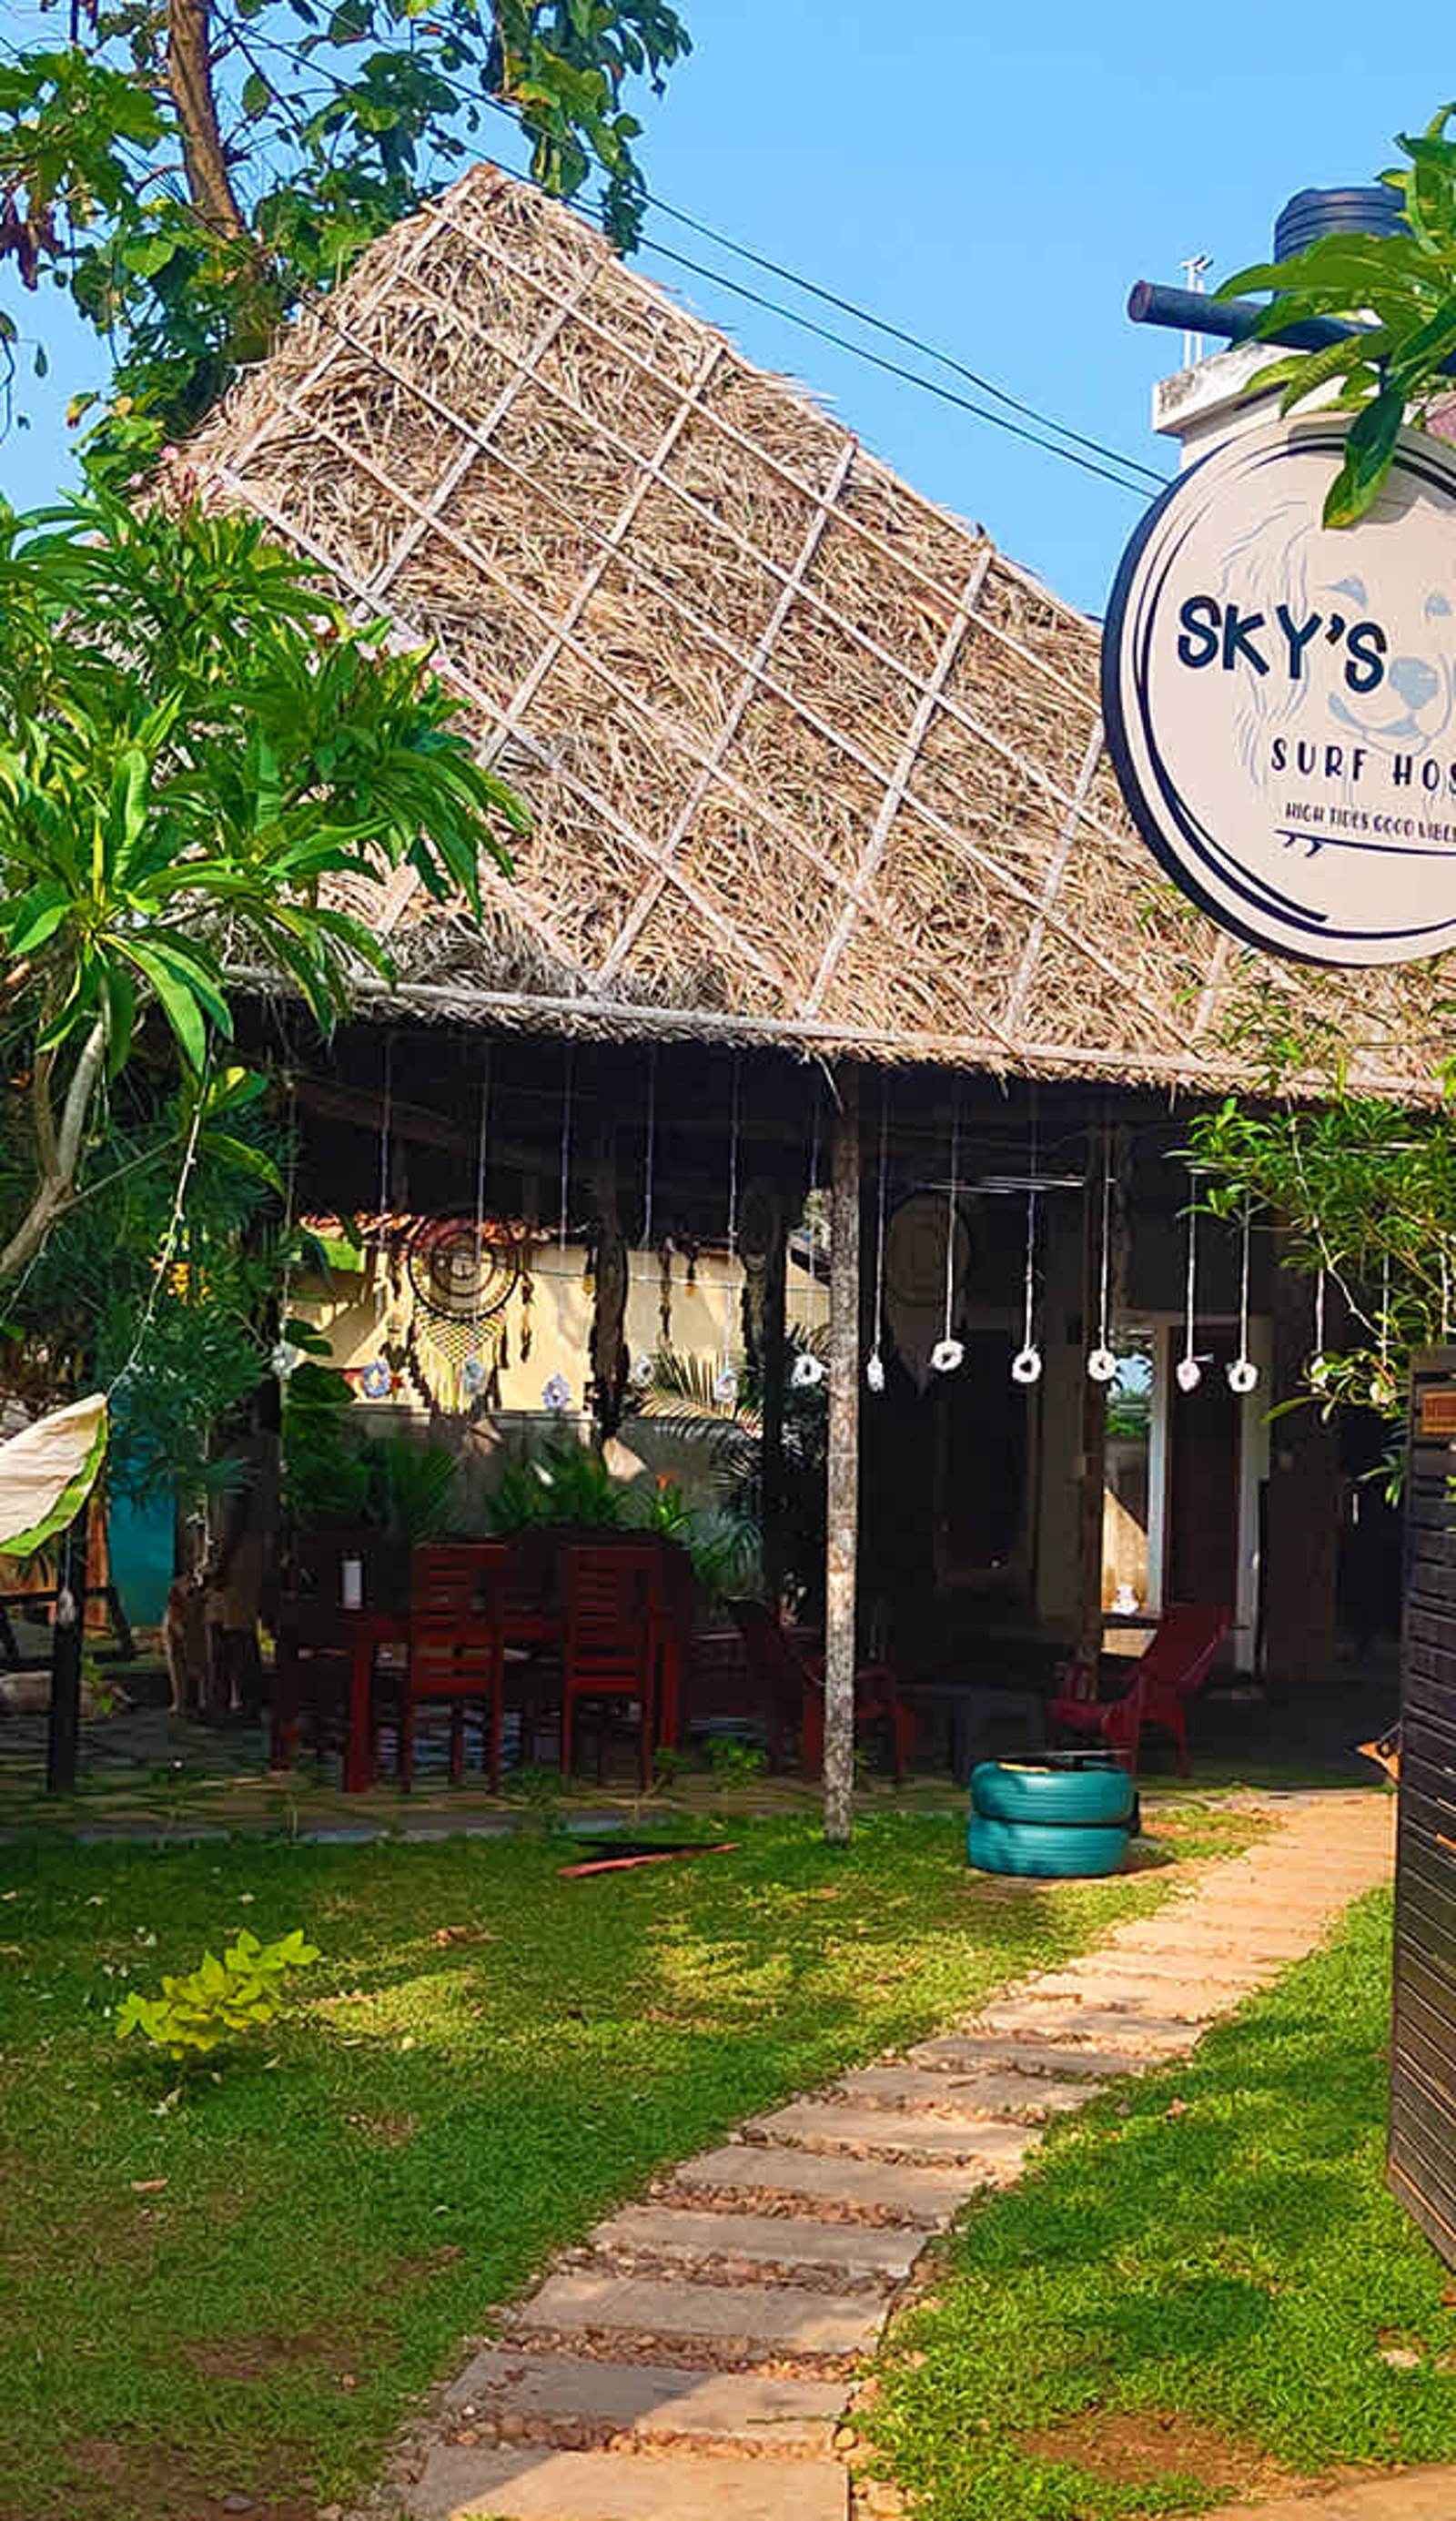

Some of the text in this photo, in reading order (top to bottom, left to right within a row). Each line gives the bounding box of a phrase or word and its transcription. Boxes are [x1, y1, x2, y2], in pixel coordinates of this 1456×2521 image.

[1178, 595, 1387, 694] SKY'S
[1270, 737, 1367, 781] SURF
[1285, 802, 1325, 823] HIGH
